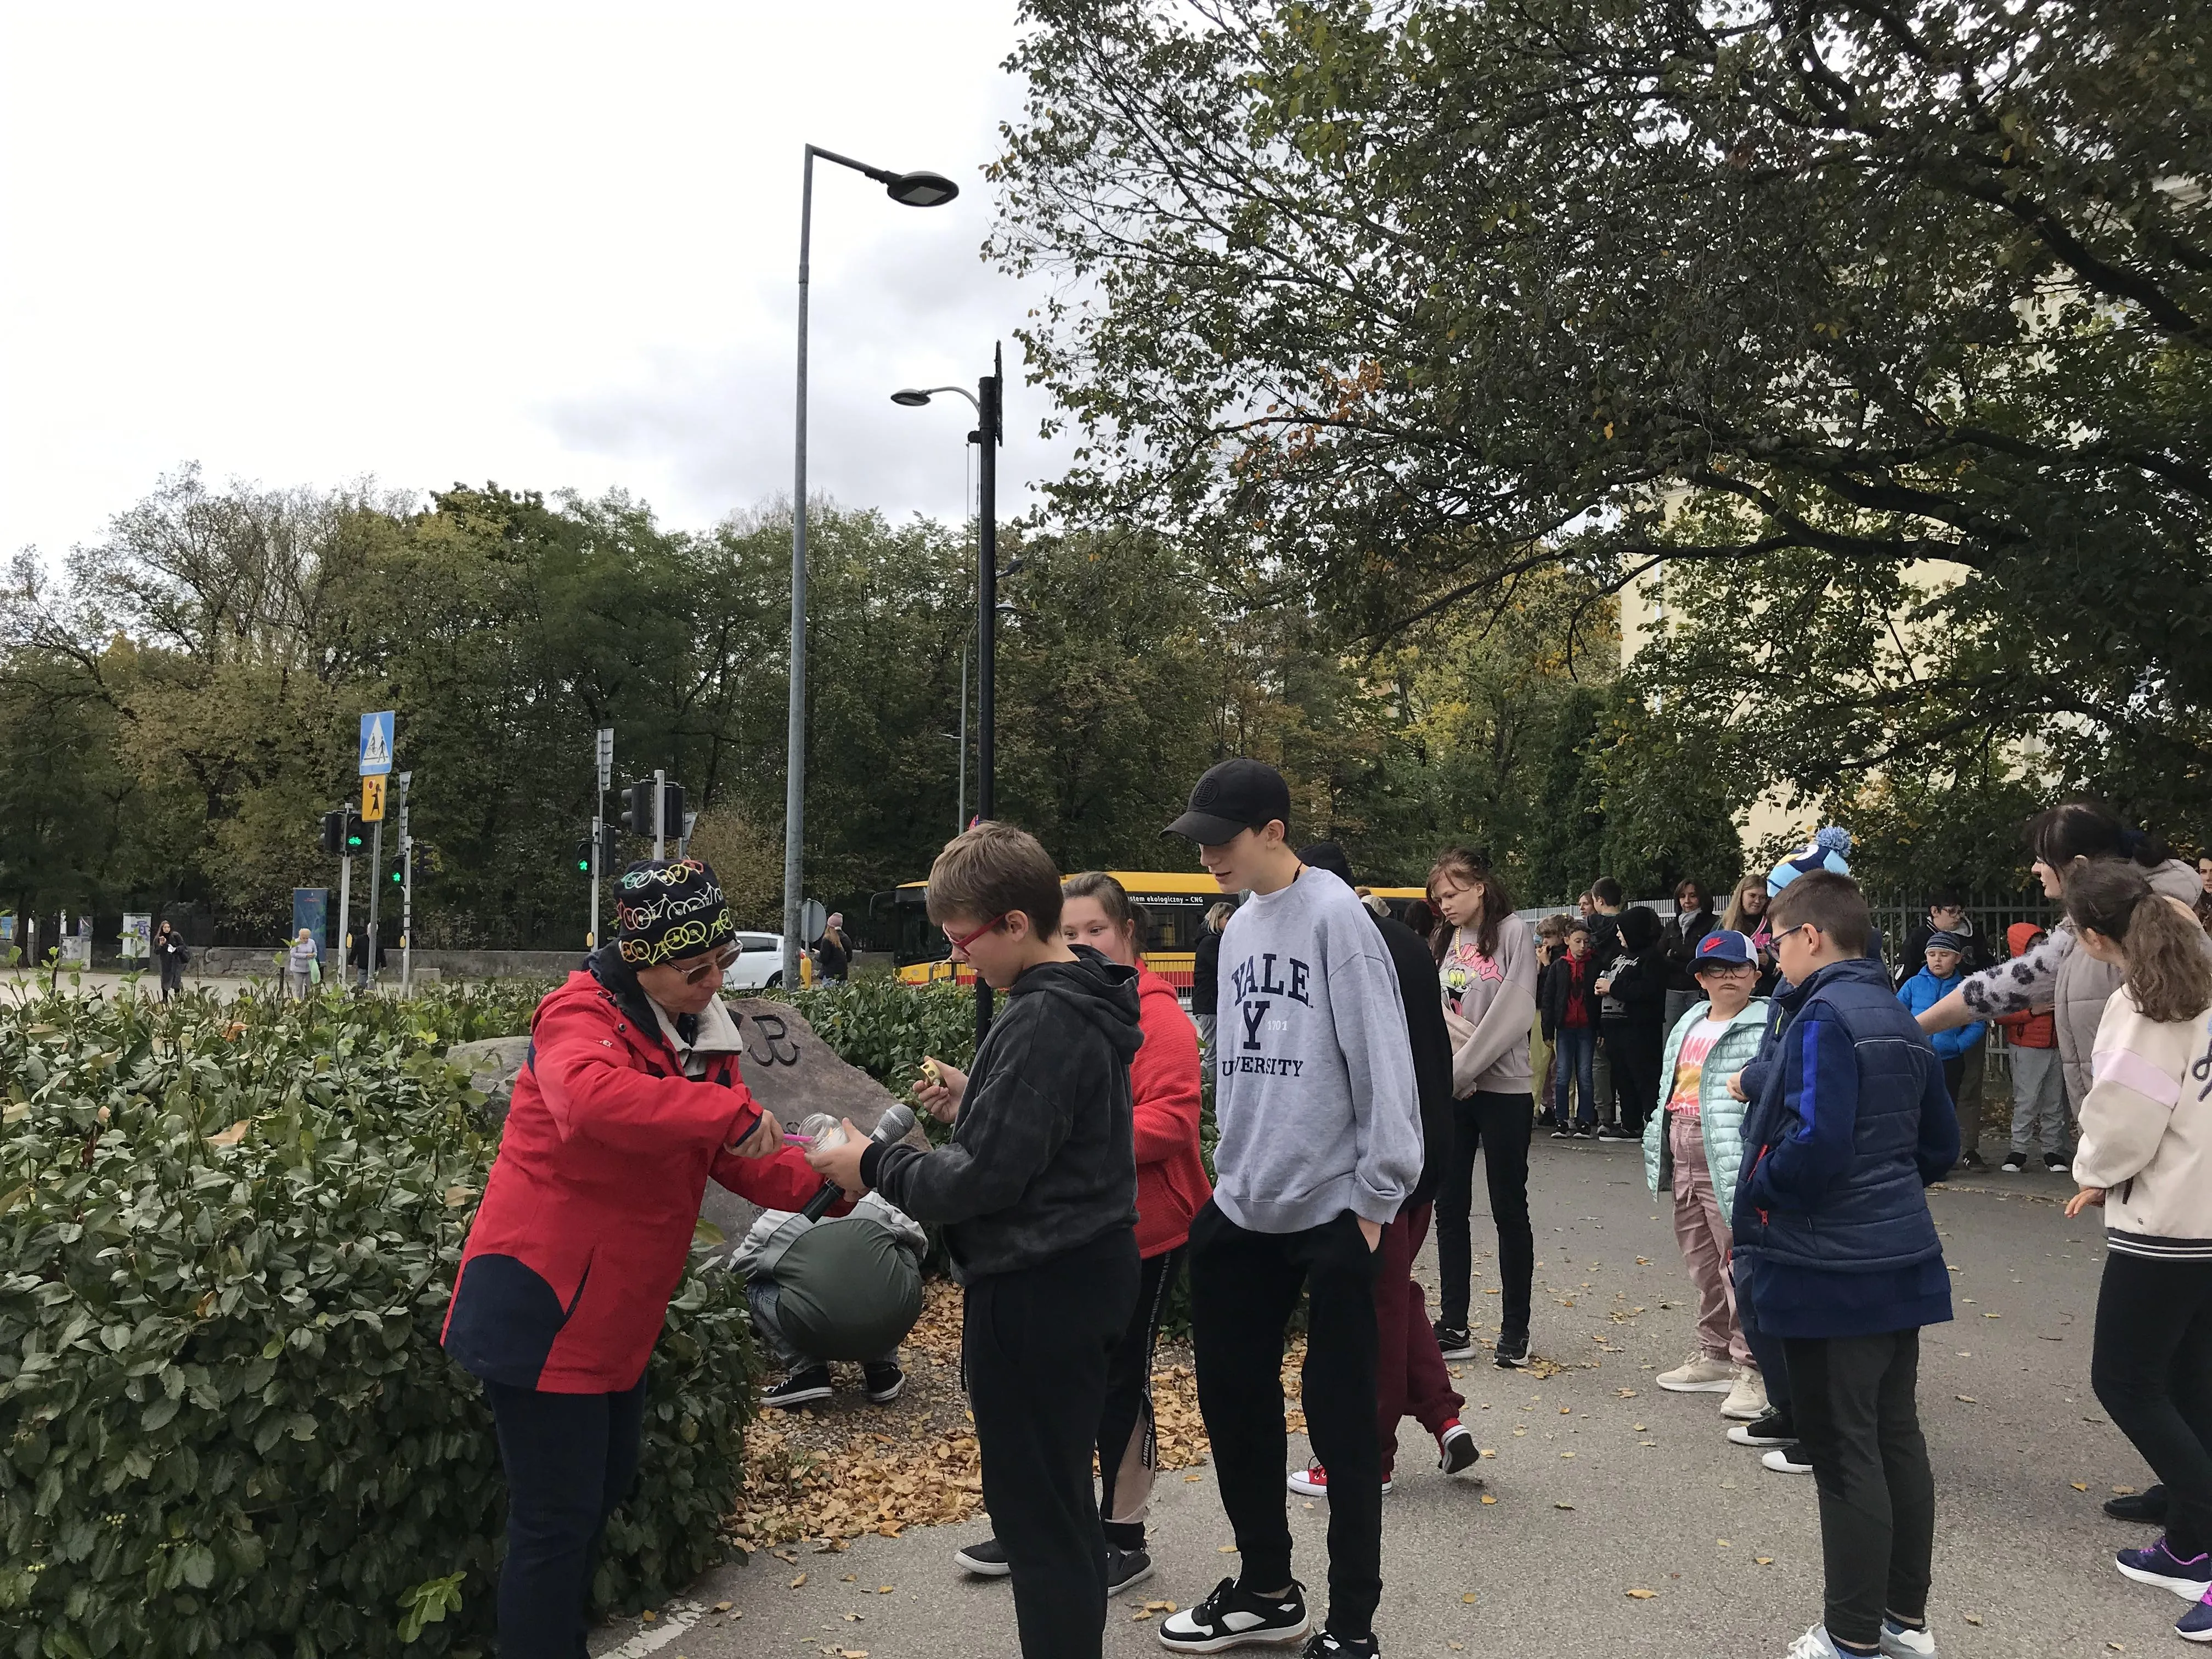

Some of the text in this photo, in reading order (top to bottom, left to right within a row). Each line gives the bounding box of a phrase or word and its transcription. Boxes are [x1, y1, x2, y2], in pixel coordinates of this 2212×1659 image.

[1147, 895, 1183, 904] ekologiczny
[1231, 953, 1310, 1007] YALE
[1243, 1000, 1270, 1050] Y
[1267, 1020, 1288, 1031] 1701
[1222, 1056, 1304, 1077] UERSITY
